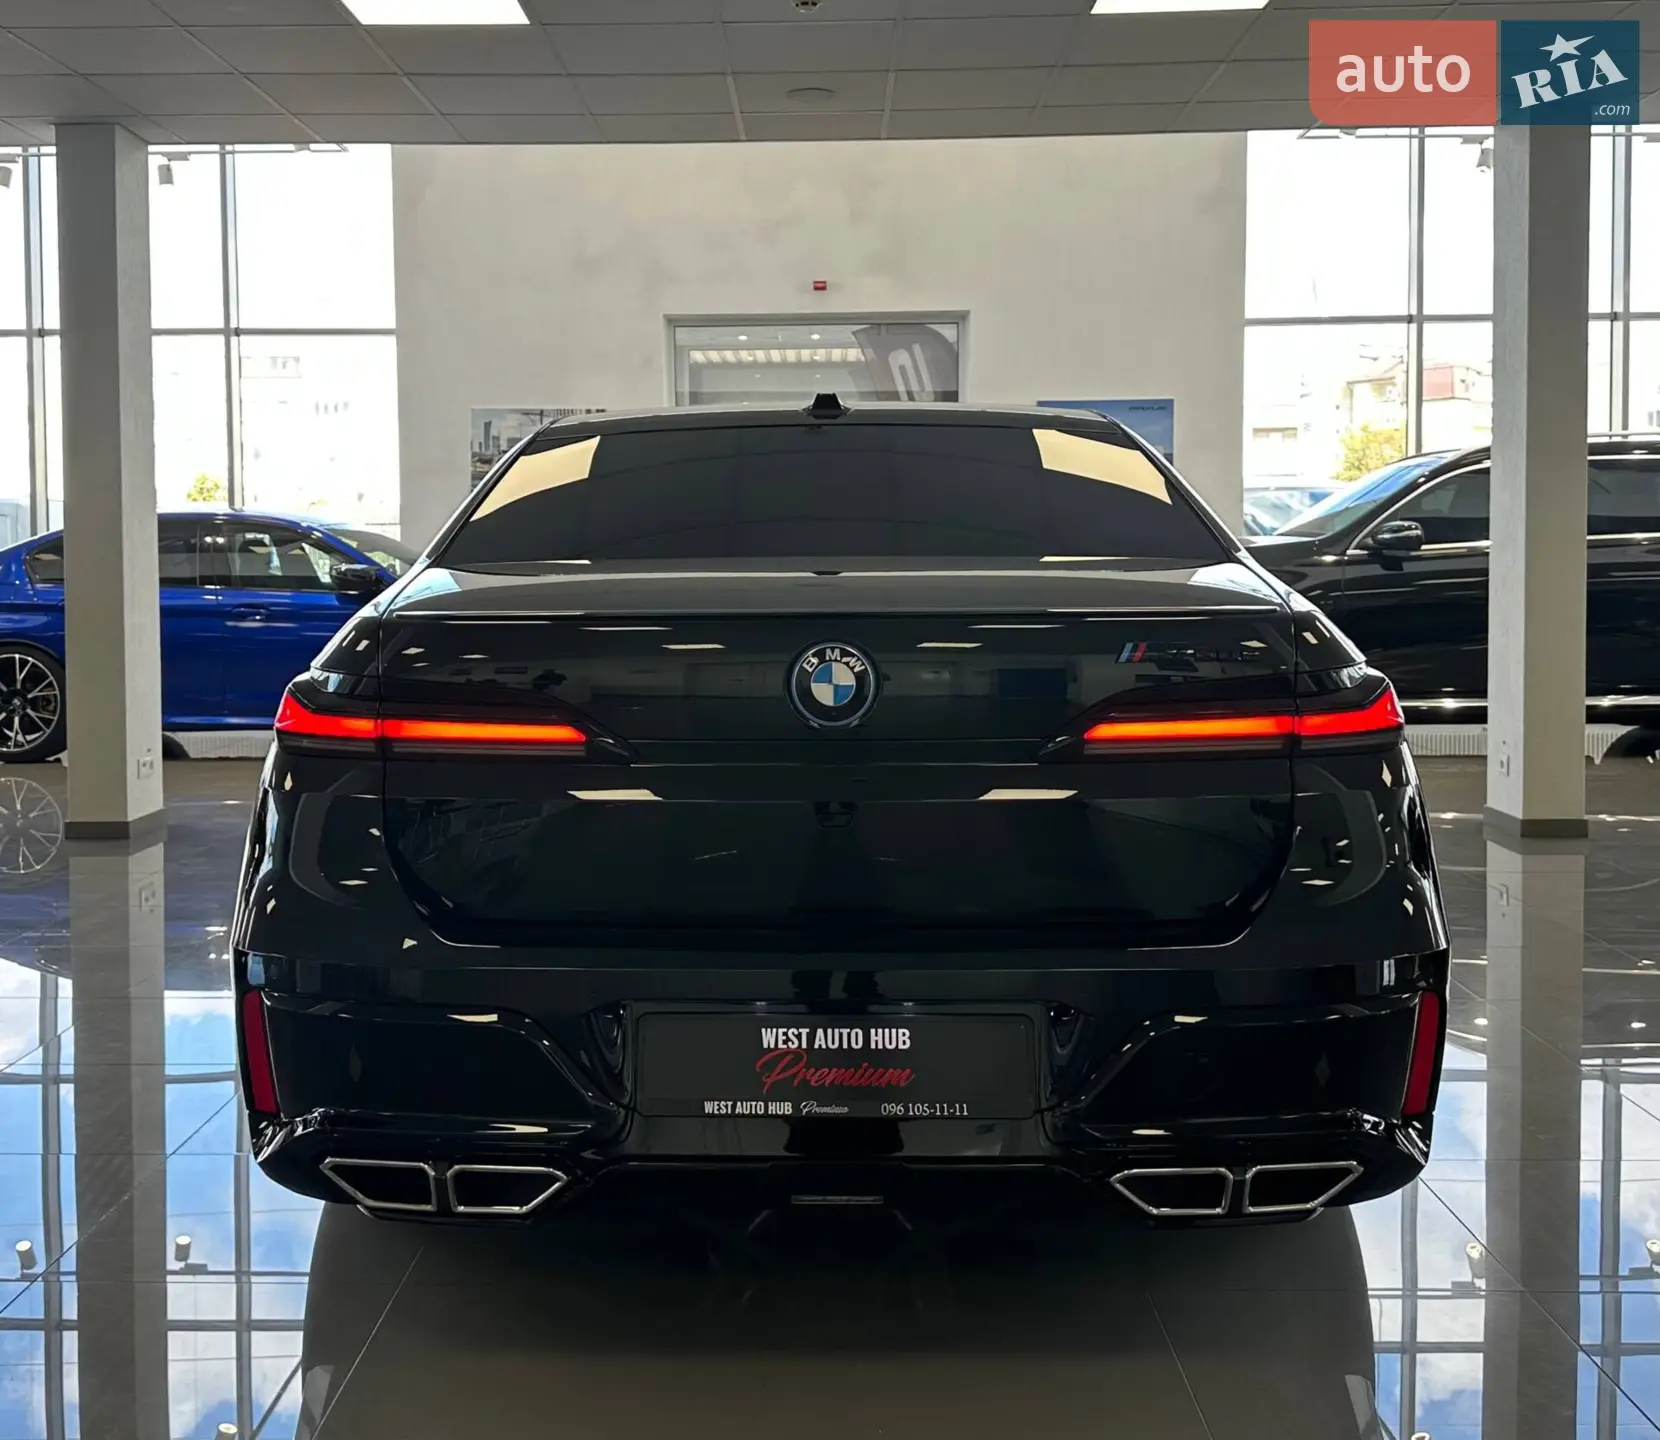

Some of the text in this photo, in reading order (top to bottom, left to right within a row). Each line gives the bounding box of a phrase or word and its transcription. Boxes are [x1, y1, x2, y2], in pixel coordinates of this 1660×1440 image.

[802, 648, 865, 673] BMW
[761, 1028, 911, 1049] WEST AUTO HUB
[755, 1048, 915, 1096] Premium
[704, 1101, 733, 1115] WEST
[735, 1101, 765, 1115] AUTO
[768, 1101, 793, 1115] HUB
[881, 1102, 905, 1116] 096
[908, 1103, 969, 1116] 105-11-11
